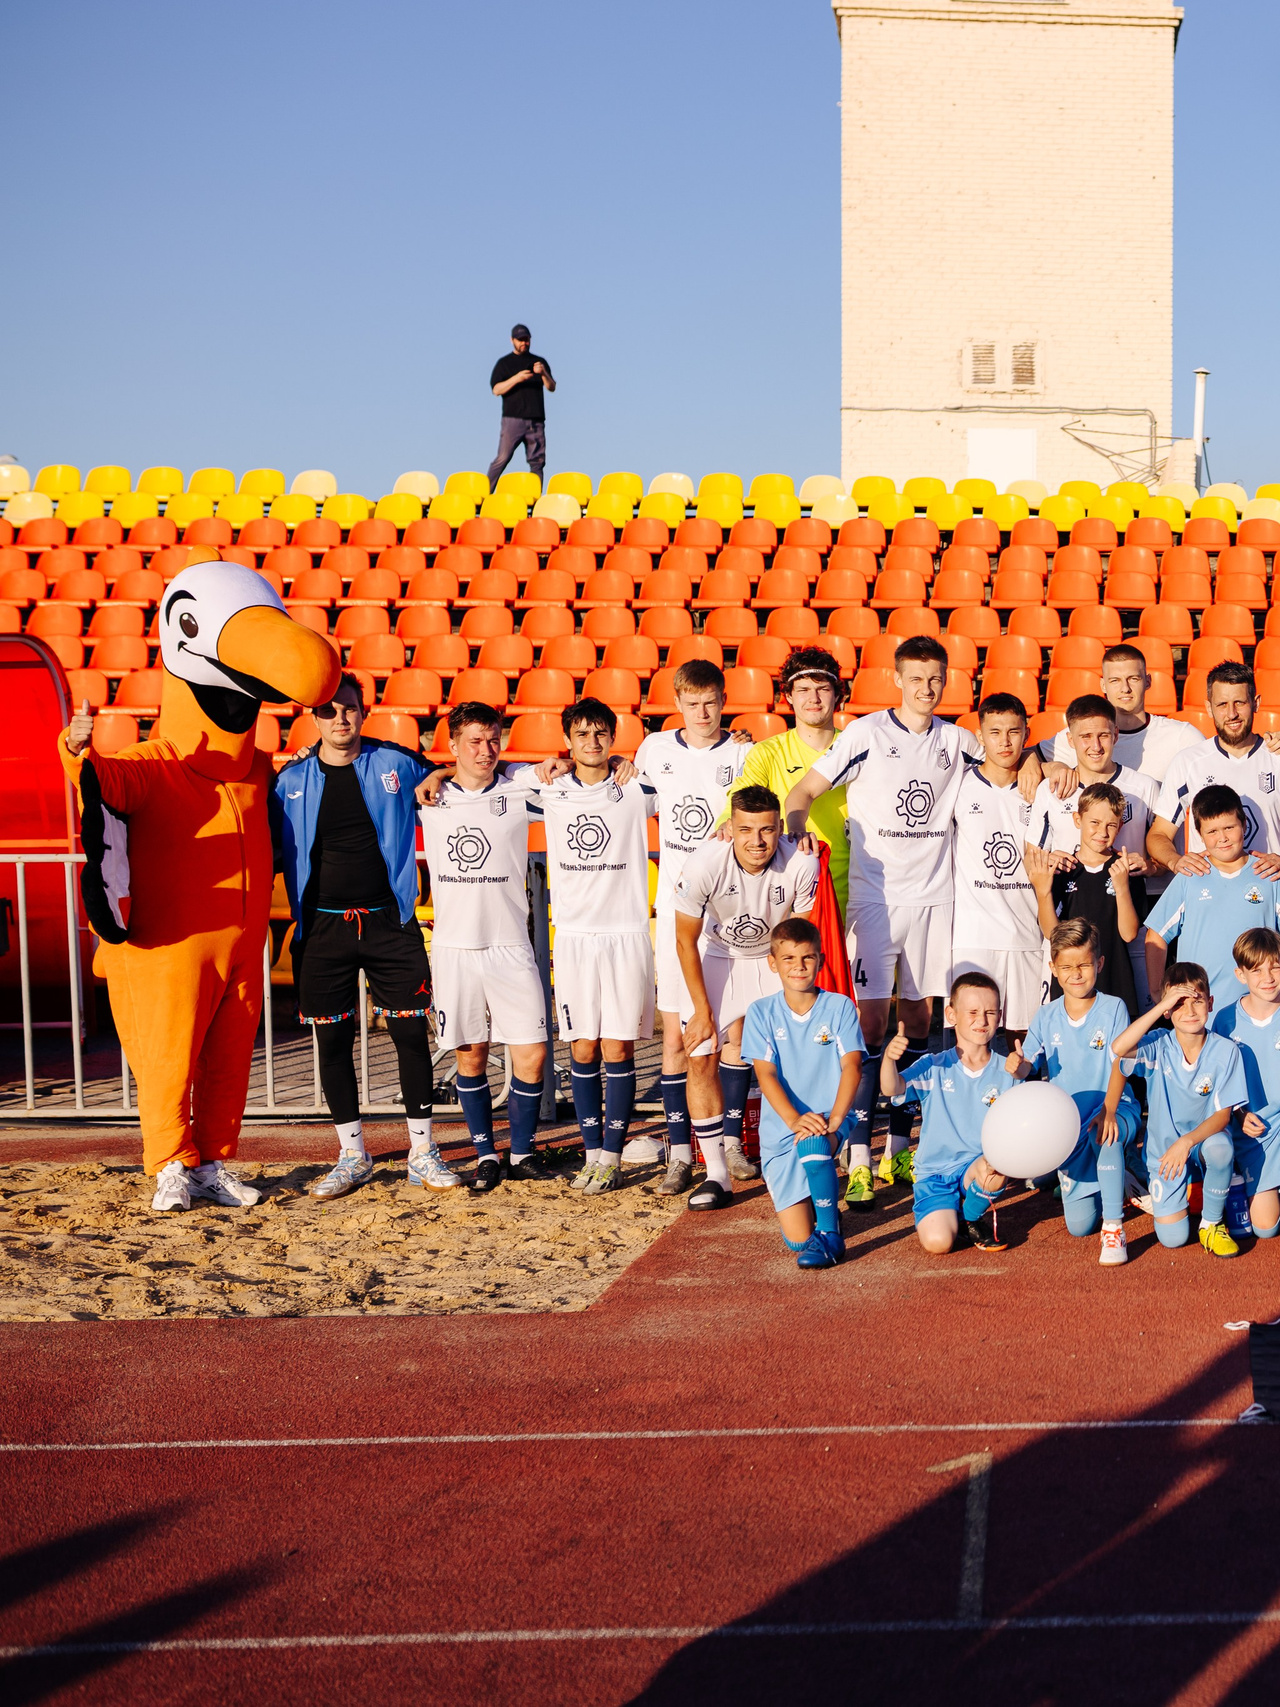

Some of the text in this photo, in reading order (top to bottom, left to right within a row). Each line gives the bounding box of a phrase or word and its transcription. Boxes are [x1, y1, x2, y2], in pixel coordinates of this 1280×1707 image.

[878, 828, 947, 839] КубаньЭнергоРемо
[974, 879, 1035, 890] КубаньЭнергоРемо
[855, 958, 868, 987] 4
